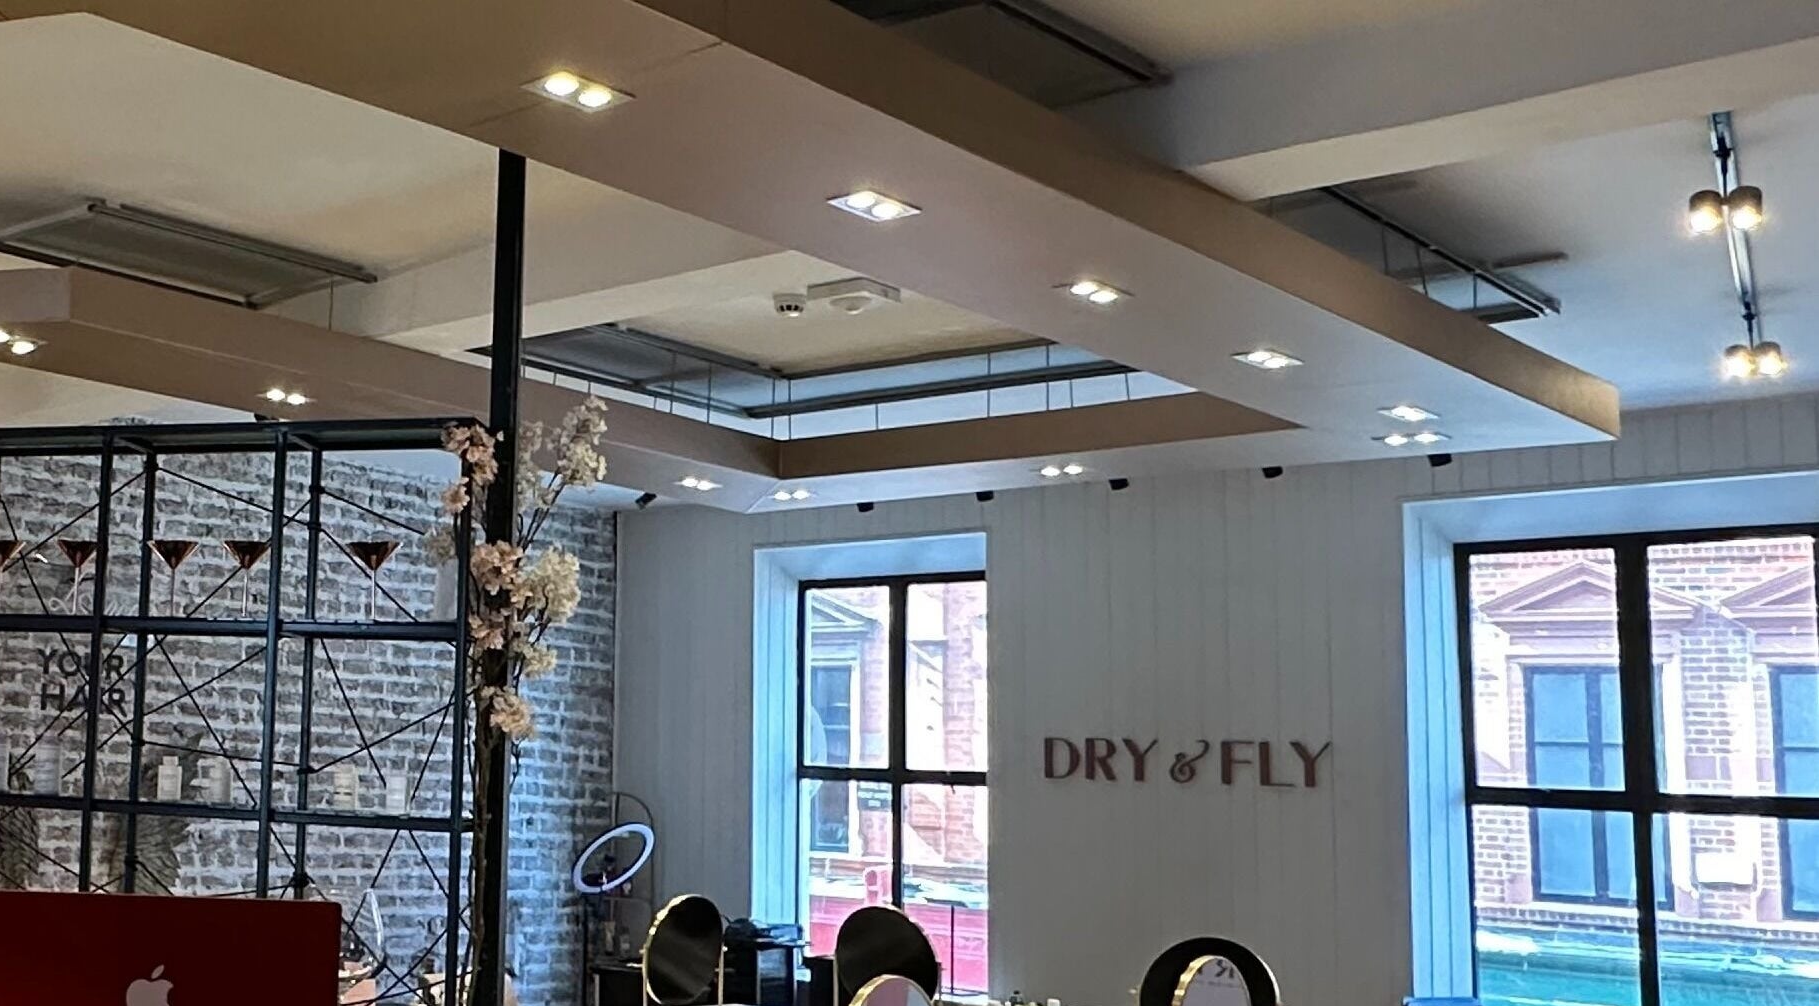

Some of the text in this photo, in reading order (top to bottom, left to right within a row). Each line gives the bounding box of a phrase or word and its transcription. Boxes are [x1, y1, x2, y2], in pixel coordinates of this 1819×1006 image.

[1043, 736, 1333, 788] DRY & FLY
